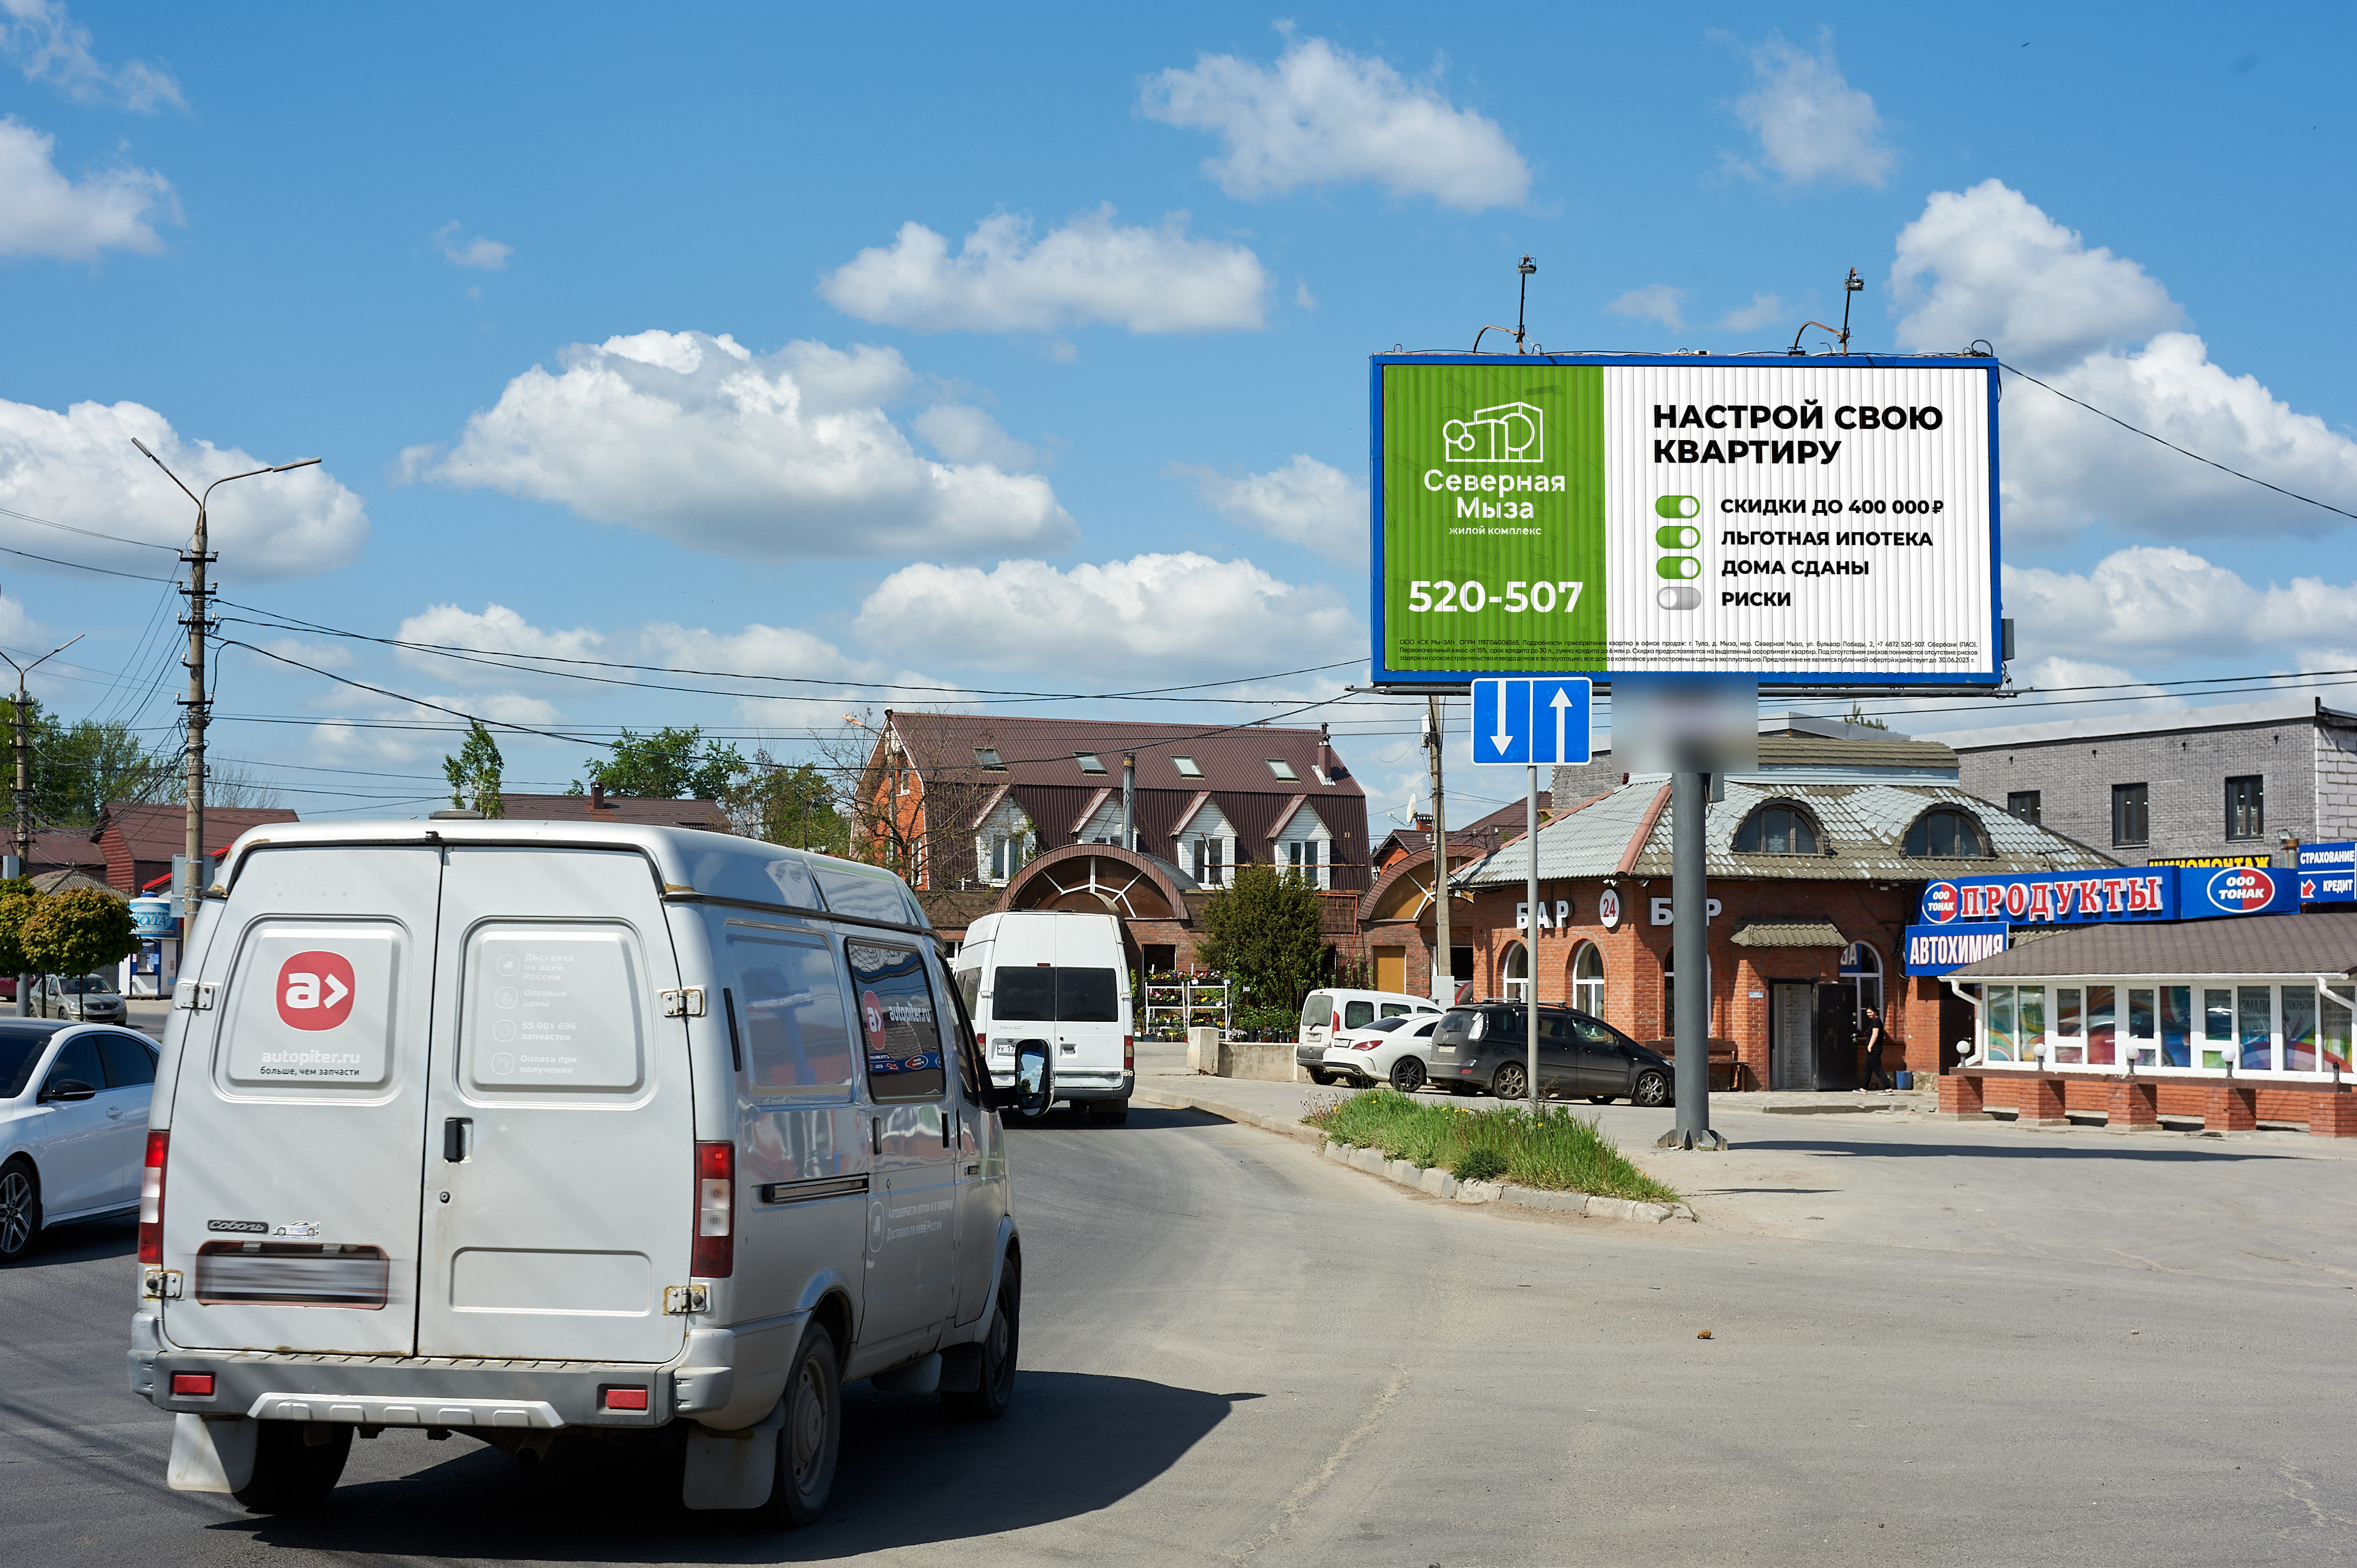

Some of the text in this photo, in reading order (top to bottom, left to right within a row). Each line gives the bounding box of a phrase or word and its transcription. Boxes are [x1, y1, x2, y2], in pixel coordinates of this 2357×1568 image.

[1653, 399, 1943, 431] НАСТРОЙ СВОЮ
[1653, 439, 1842, 465] КВАРТИРУ
[1424, 469, 1565, 498] Северная
[1457, 497, 1534, 519] Мыза
[1720, 499, 1806, 516] СКИДКИ
[1812, 499, 1843, 516] ДО
[1848, 500, 1886, 514] 400
[1449, 525, 1486, 535] жилой
[1721, 531, 1934, 546] ЛЬГОТНАЯ ИПОТЕКА
[1722, 560, 1869, 577] ДОМА СДАНЫ
[1408, 580, 1583, 613] 520-507
[1722, 591, 1791, 607] РИСКИ
[2300, 850, 2355, 864] СТРАХОВАНИЕ
[2226, 876, 2255, 887] ООО
[2323, 879, 2353, 894] КРЕДИТ
[1932, 891, 1950, 901] ООО
[1960, 876, 2163, 921] ПРОДУКТЫ
[2218, 888, 2264, 900] ТОНАК
[1516, 900, 1569, 929] БАР
[1603, 898, 1616, 918] 24
[1651, 897, 1722, 926] БР
[1928, 901, 1955, 912] ТОНАК
[1910, 933, 2004, 965] АВТОХИМИЯ
[524, 954, 574, 962] Доставка
[888, 1001, 931, 1026] autopiter.ru
[2242, 1000, 2270, 1014] ЭМАЛИ
[2286, 1000, 2315, 1011] ПОКРЫТИЯ
[261, 1049, 361, 1066] autopiter.ru
[520, 1055, 577, 1065] Оплата при
[260, 1066, 297, 1076] больше,
[520, 1066, 573, 1075] получении
[888, 1205, 917, 1219] Автозапчасти
[918, 1203, 930, 1214] оптом
[937, 1199, 954, 1213] розницу
[886, 1220, 942, 1243] Доставка по всей России
